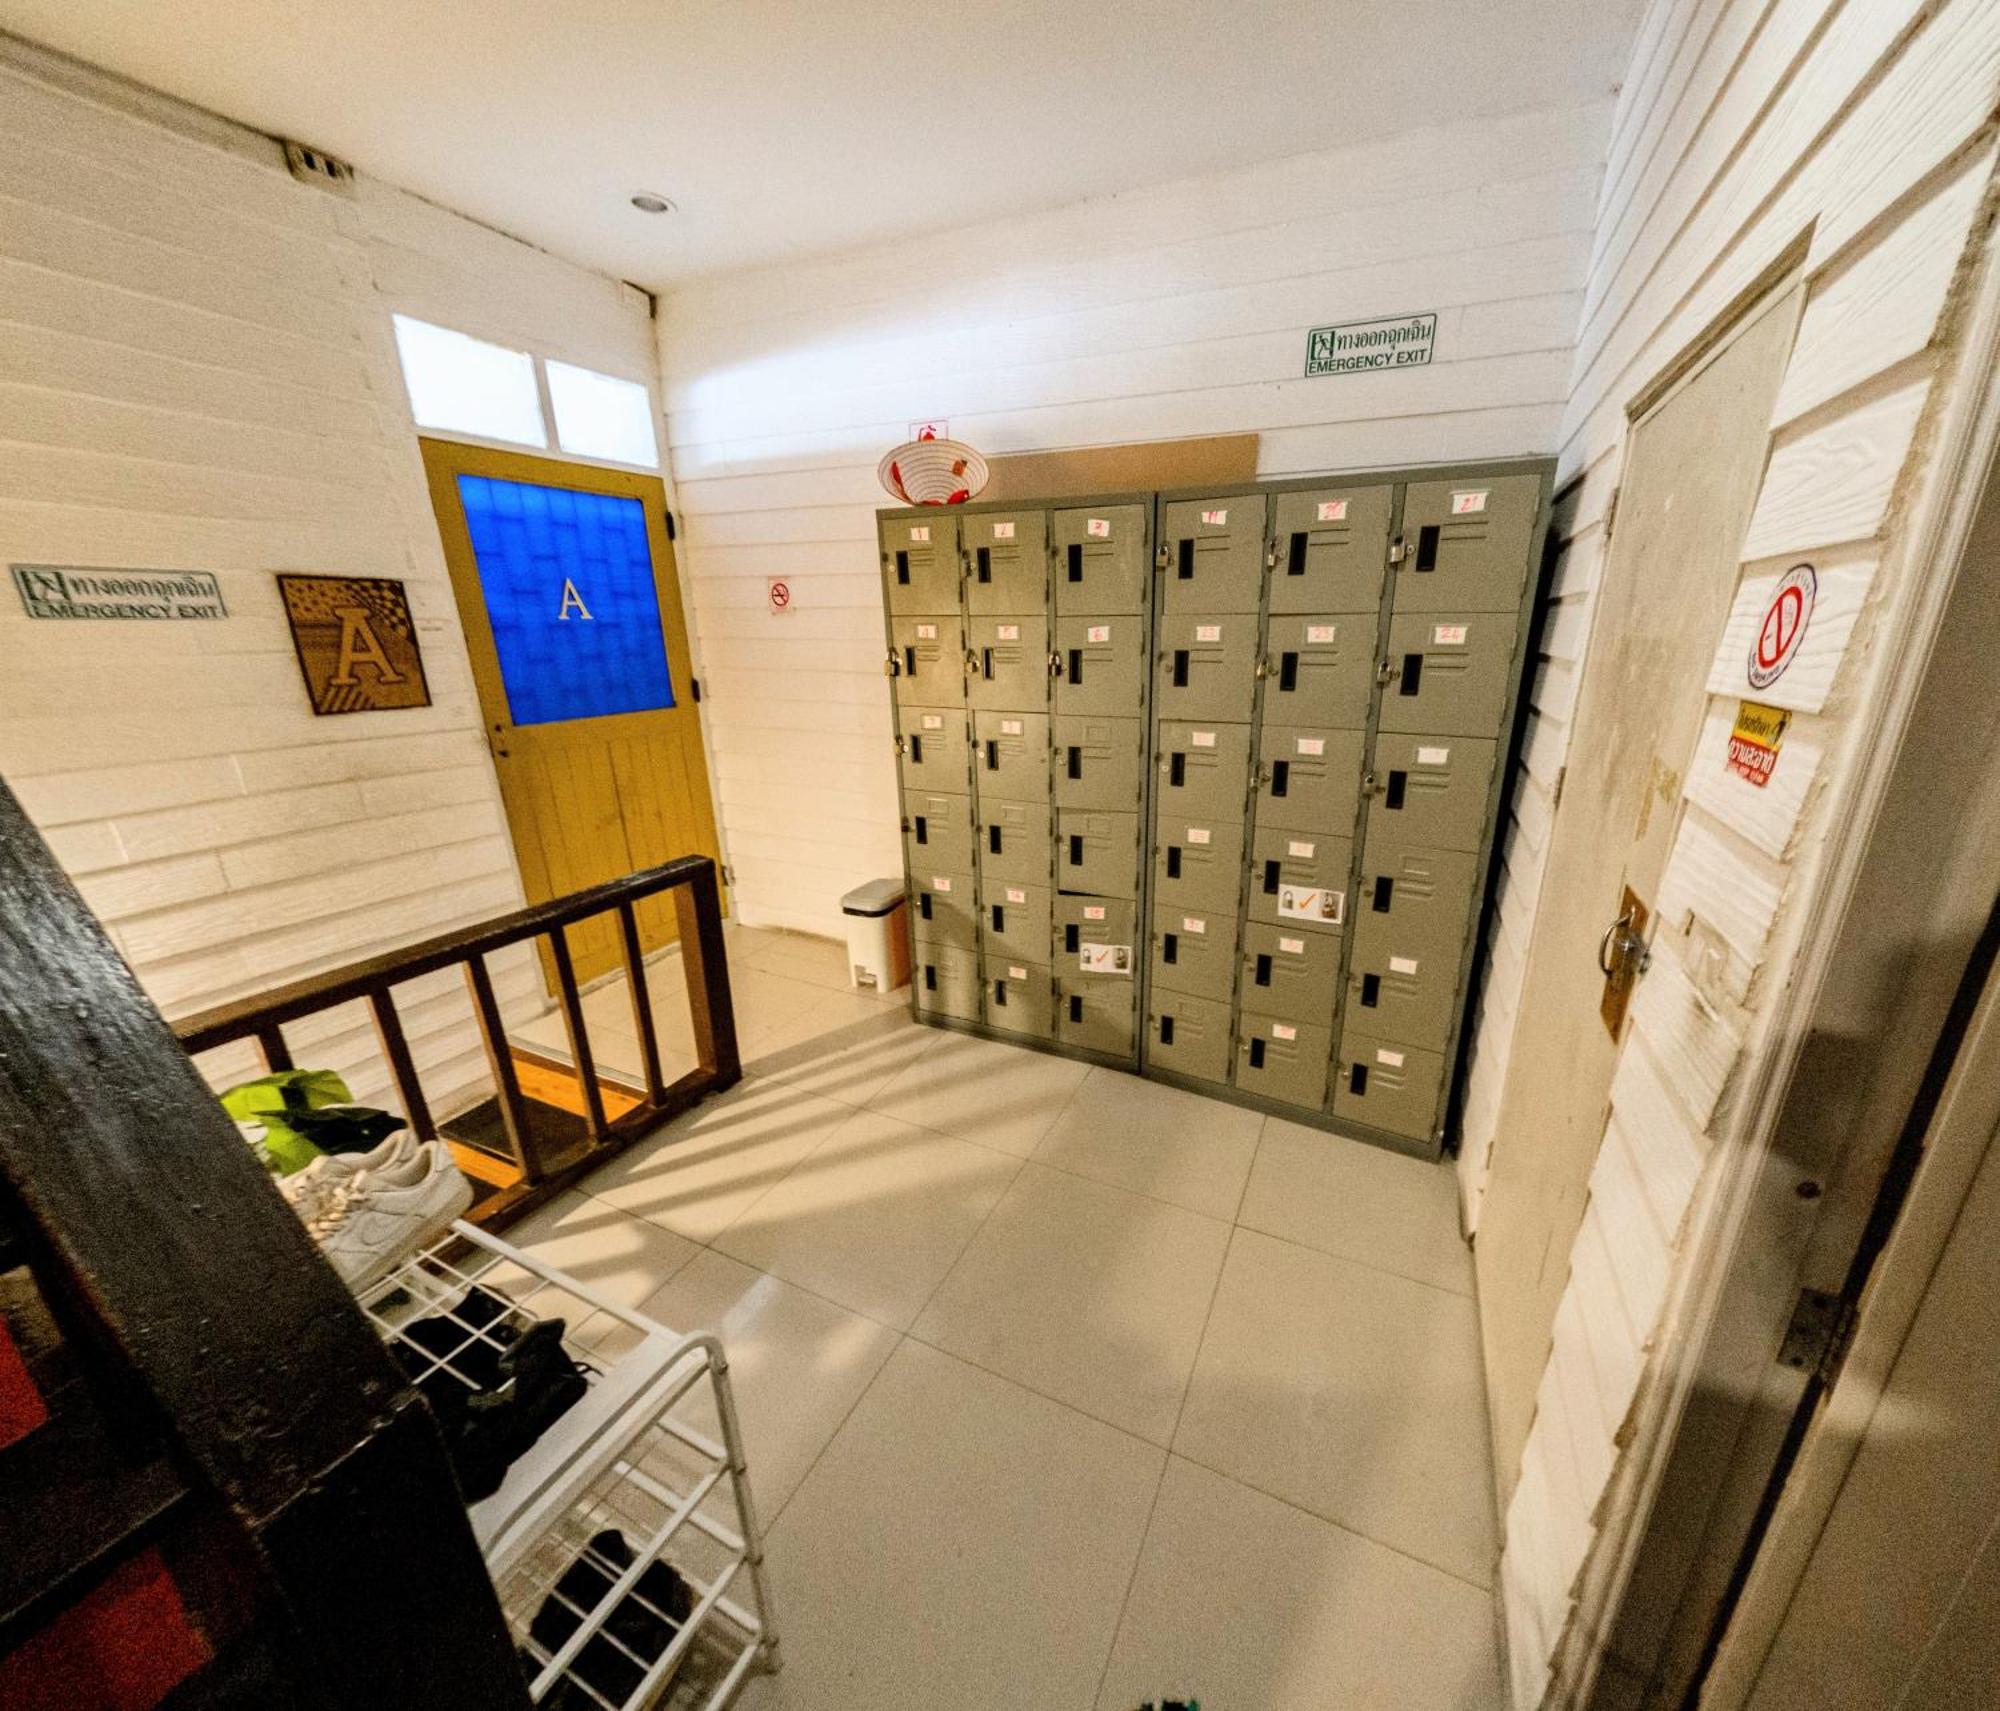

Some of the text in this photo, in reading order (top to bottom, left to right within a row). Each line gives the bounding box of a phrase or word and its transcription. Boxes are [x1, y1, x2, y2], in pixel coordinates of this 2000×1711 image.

[1337, 319, 1432, 350] ทางออกฉุกเฉิน
[1308, 349, 1428, 374] EMERGENCY EXIT
[30, 602, 219, 618] EMERGENCY EXIT
[558, 577, 594, 620] A
[329, 605, 406, 685] A
